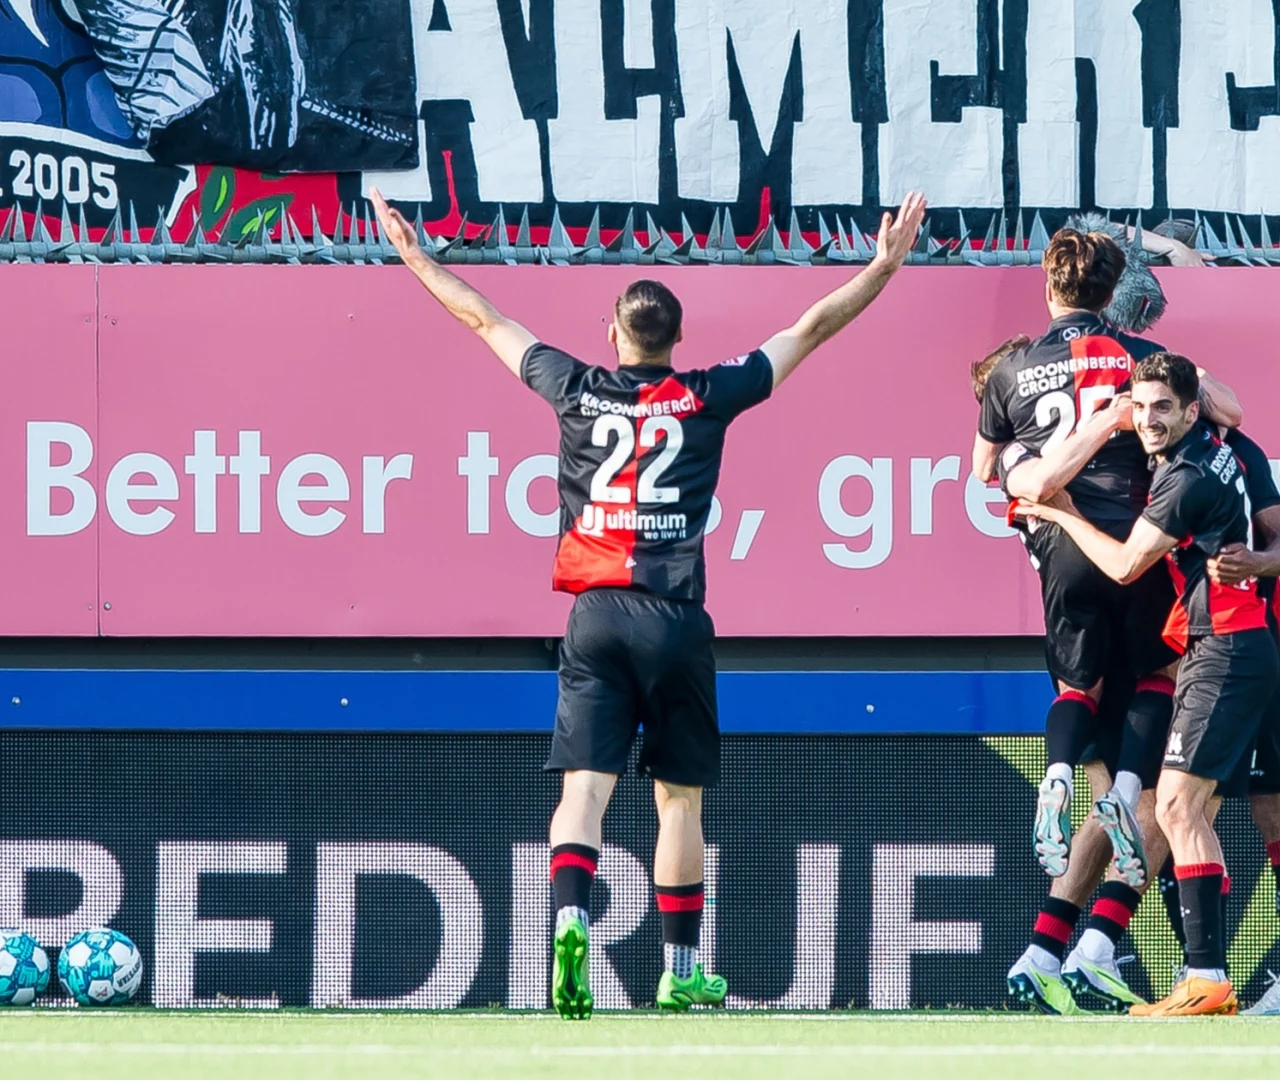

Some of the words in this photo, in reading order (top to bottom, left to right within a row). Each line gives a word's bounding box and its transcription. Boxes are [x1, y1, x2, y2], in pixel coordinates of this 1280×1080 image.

[10, 152, 118, 207] 2005
[1017, 353, 1127, 383] KROONENBERG
[1018, 376, 1068, 398] GROEP
[580, 392, 694, 418] KROONENBERG
[26, 420, 413, 537] Better
[589, 413, 685, 504] 22
